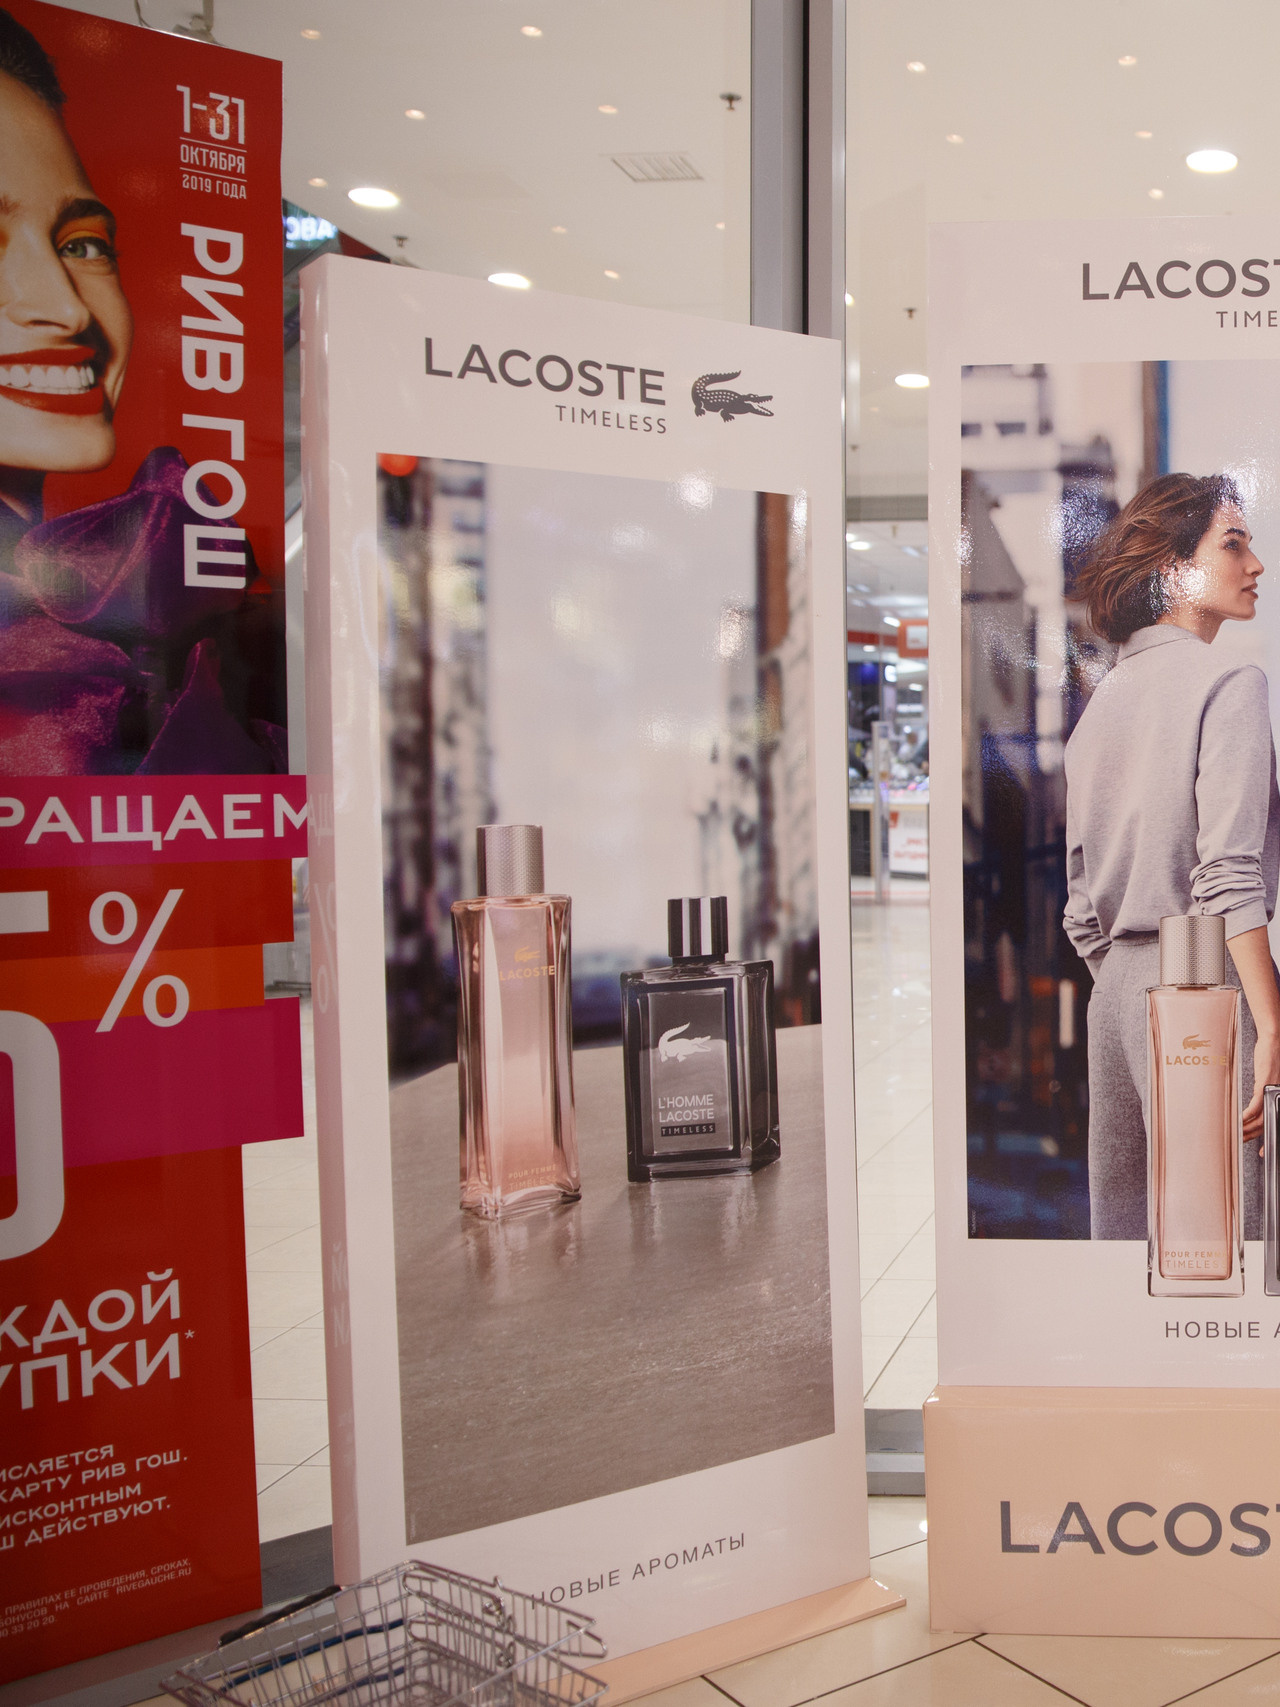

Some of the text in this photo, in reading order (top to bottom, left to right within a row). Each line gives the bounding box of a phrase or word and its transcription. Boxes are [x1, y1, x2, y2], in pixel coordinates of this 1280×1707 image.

[176, 84, 245, 144] 1-31
[180, 144, 245, 174] ОКТЯБРЯ
[182, 174, 247, 200] 2019 ГОДА
[424, 337, 666, 406] LACOSTE
[181, 222, 246, 590] РИВ ГОШ
[555, 404, 667, 434] TIMELESS
[499, 965, 555, 982] LACOSTE
[1165, 1055, 1228, 1066] LACOSTE
[658, 1094, 714, 1109] L'HOMME
[659, 1108, 715, 1123] LACOSTE
[661, 1124, 714, 1135] TIMELESS
[1165, 1260, 1227, 1269] TIMELESS
[1165, 1321, 1260, 1339] НОВЫЕ
[82, 1462, 126, 1484] РИВ
[135, 1449, 188, 1472] ГОШ.
[24, 1495, 171, 1547] ДЕЙСТВУЮТ.
[531, 1533, 746, 1610] НОВЫЕ АРОМАТЫ
[5, 1593, 61, 1616] ПРАВИЛАХ
[64, 1587, 77, 1599] ЕЕ
[55, 1602, 70, 1612] НА
[76, 1590, 110, 1606] САЙТЕ
[117, 1566, 192, 1595] RIVEGAUCHE.RU
